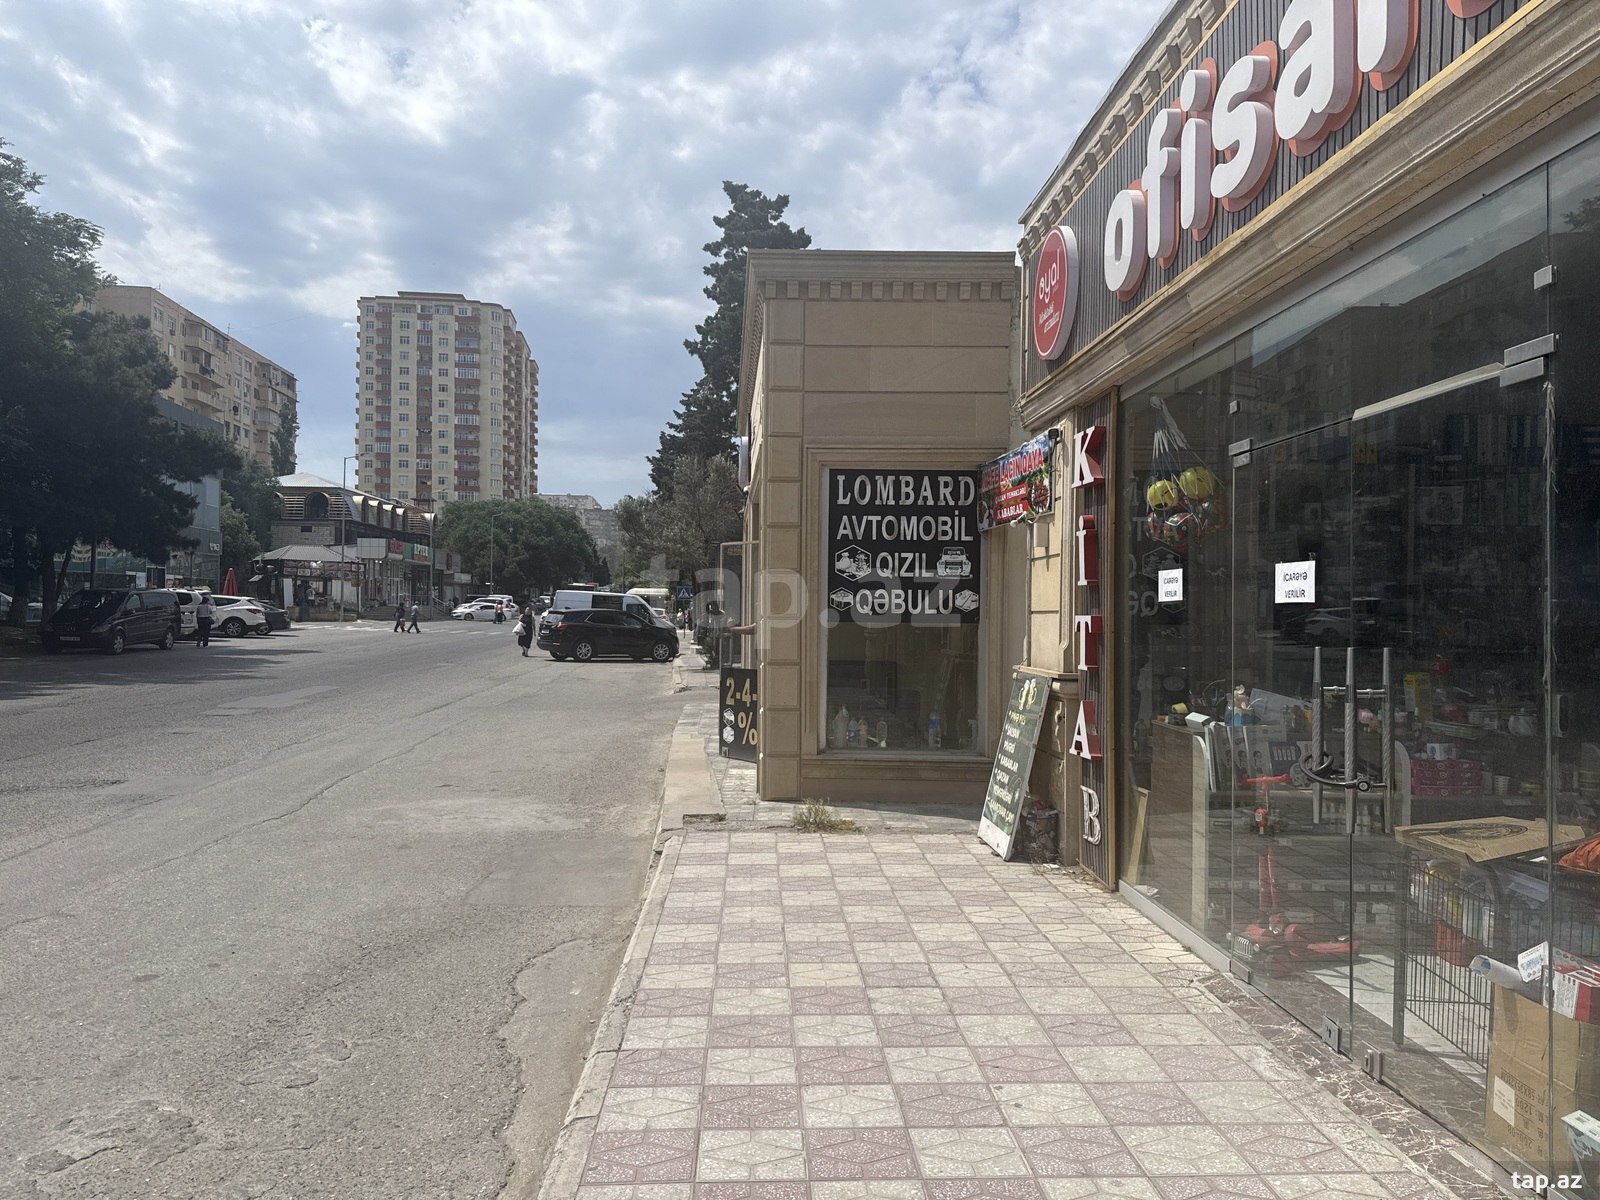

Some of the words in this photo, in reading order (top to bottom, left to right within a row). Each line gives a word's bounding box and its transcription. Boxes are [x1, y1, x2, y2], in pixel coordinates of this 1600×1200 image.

[836, 474, 975, 506] LOMBARD
[836, 509, 974, 541] AVTOMOBİL
[875, 551, 935, 579] QIZIL
[855, 588, 953, 616] QƏBULU
[1070, 426, 1103, 845] KİTAB
[737, 711, 757, 745] %
